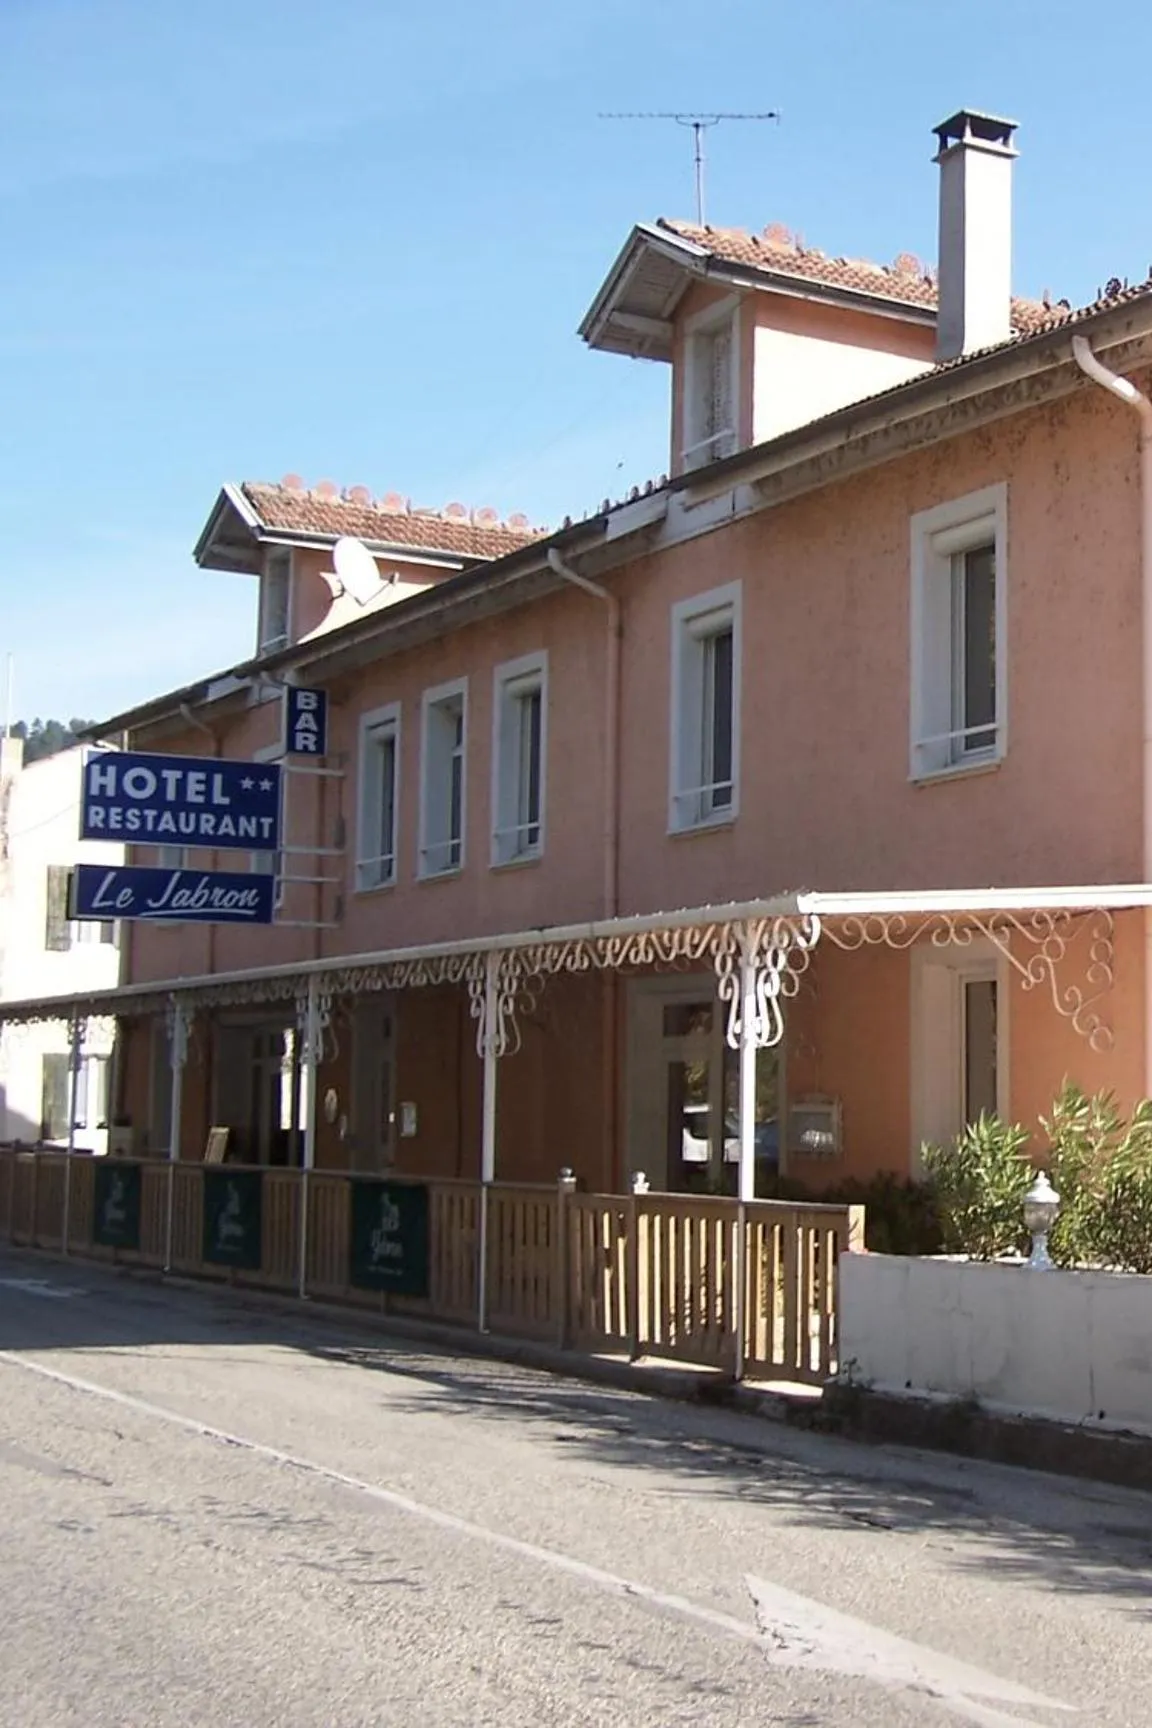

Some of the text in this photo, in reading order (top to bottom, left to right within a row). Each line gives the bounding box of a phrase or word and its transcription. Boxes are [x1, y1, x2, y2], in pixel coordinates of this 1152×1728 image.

[294, 690, 319, 751] BAR
[89, 763, 231, 806] HOTEL
[88, 805, 275, 839] RESTAURANT
[91, 871, 260, 910] Le Jabron
